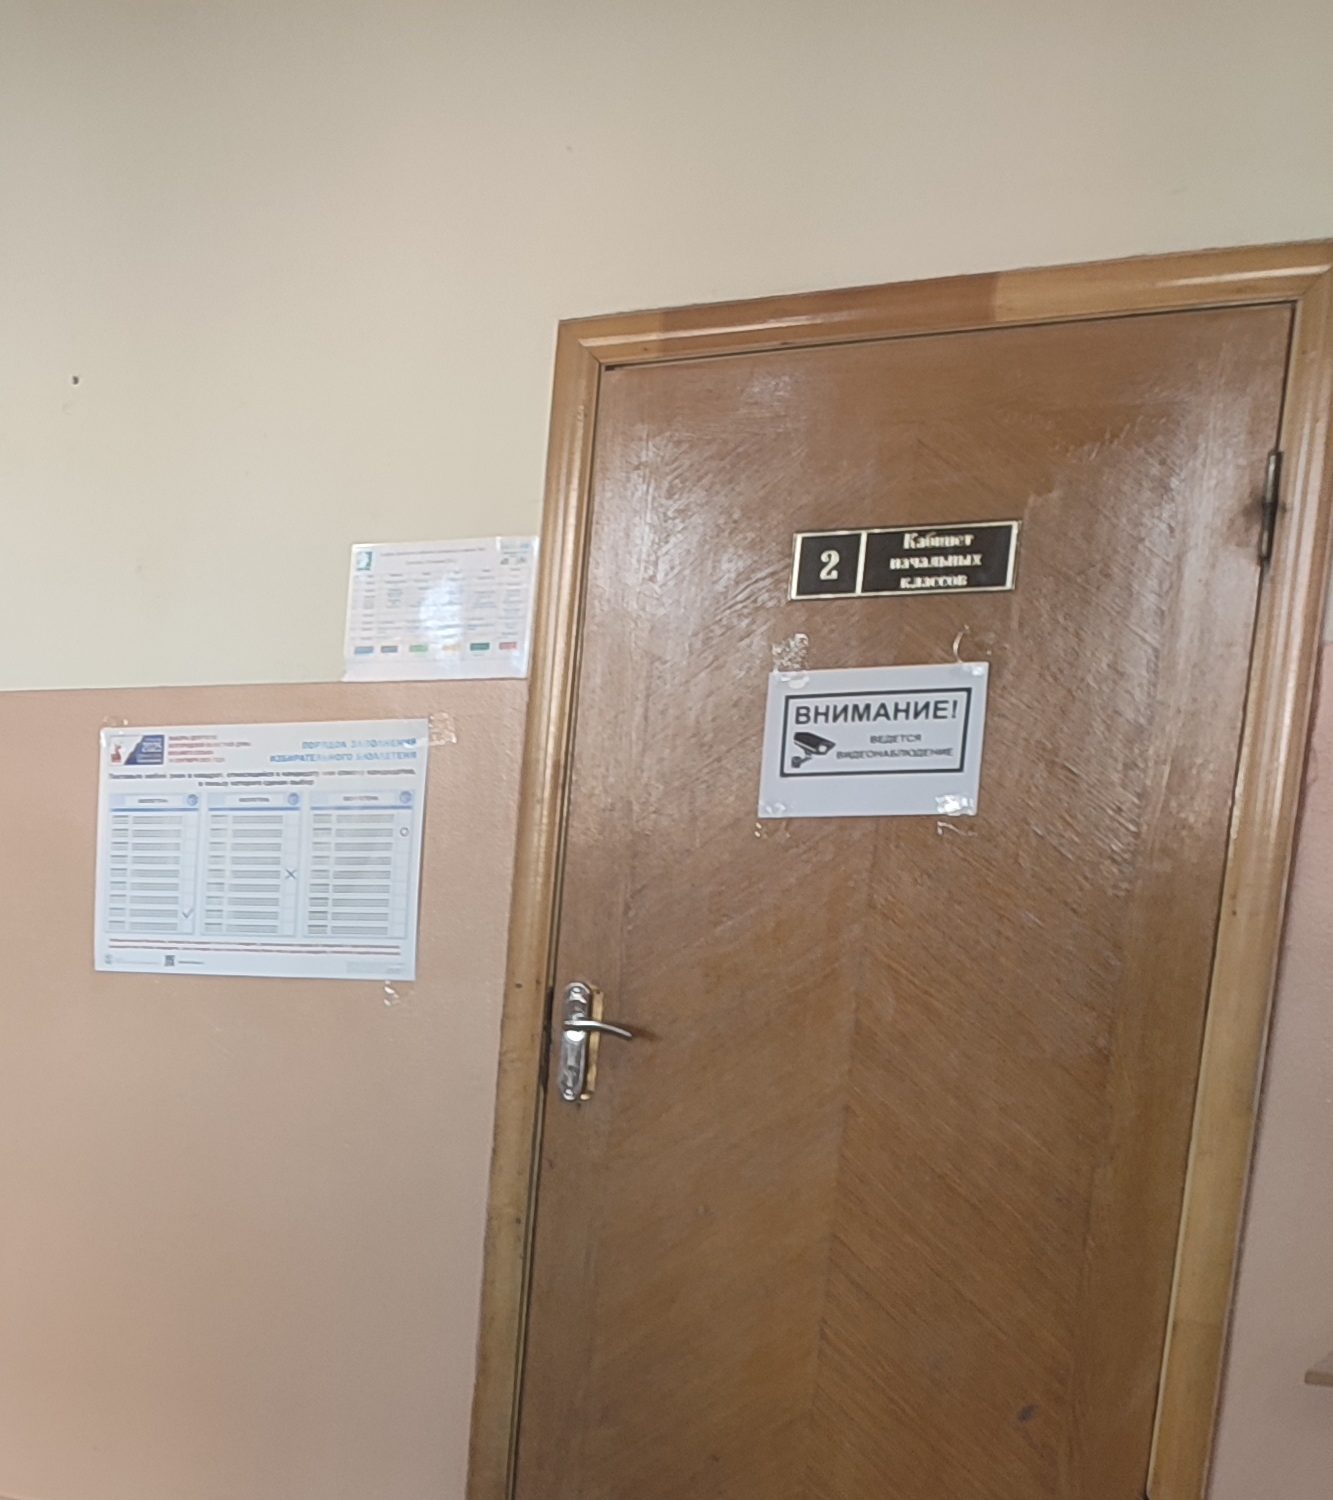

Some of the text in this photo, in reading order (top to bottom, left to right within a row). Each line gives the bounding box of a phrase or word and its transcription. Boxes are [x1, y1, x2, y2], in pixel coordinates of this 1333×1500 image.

[903, 531, 975, 550] Кабинет
[819, 549, 840, 580] 2
[889, 553, 983, 570] начальных
[899, 575, 968, 589] классов
[793, 699, 959, 726] ВНИМАНИЕ!
